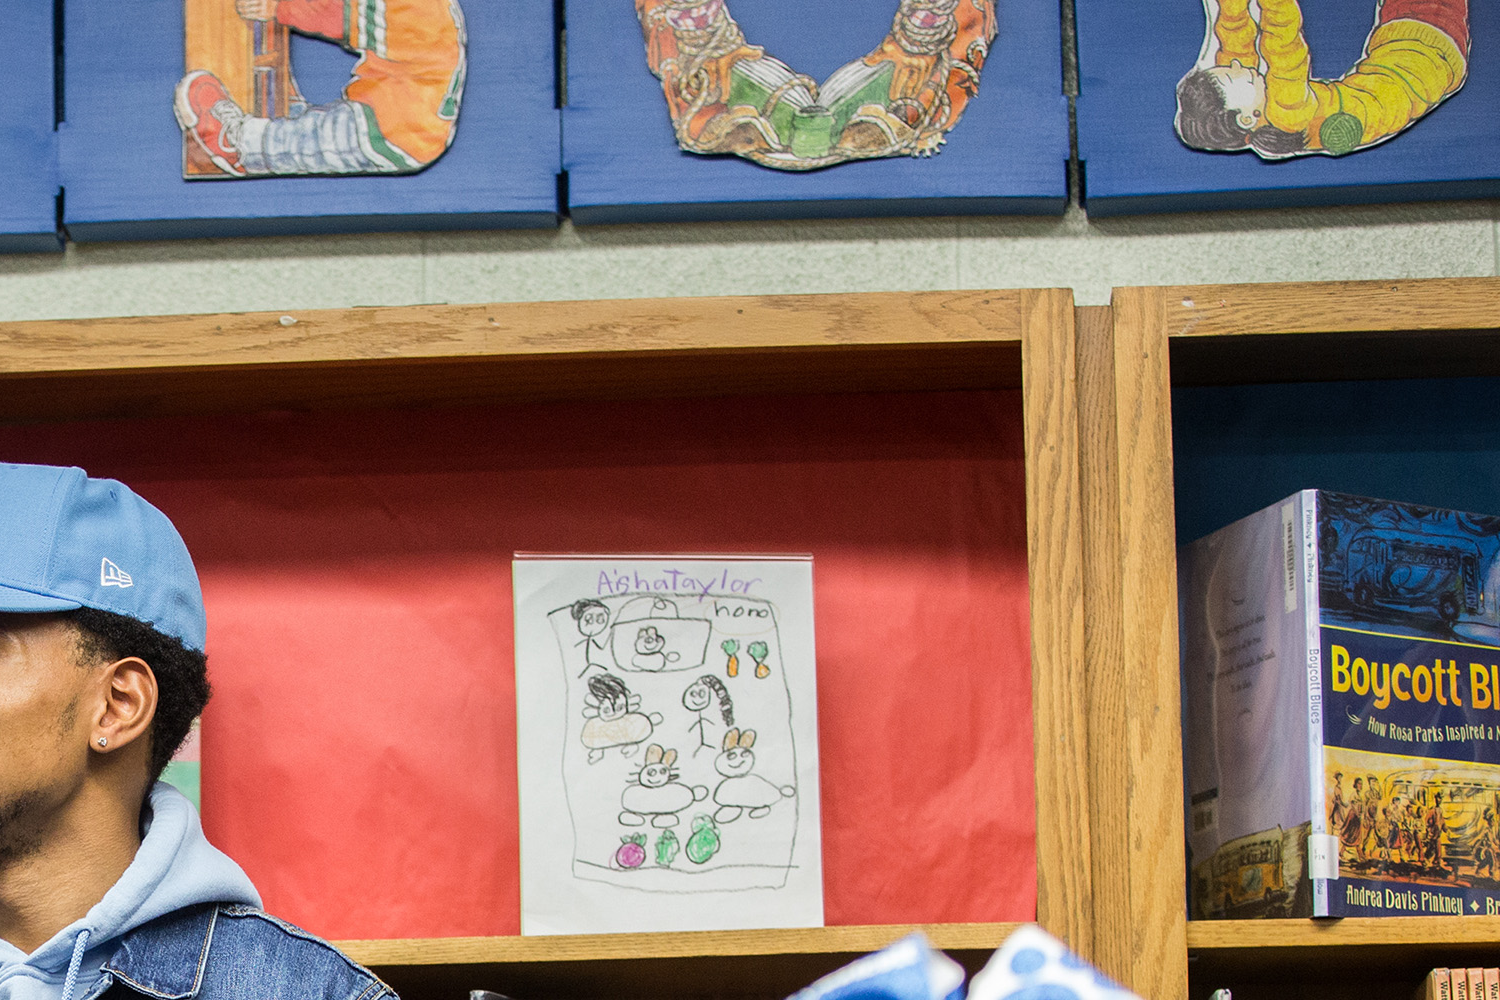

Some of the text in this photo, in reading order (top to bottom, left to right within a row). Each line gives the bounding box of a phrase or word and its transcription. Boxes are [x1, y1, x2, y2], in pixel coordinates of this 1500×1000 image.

[1308, 649, 1319, 690] Boycott
[1331, 644, 1462, 710] Boycott
[1310, 695, 1321, 724] Blues
[1367, 715, 1493, 743] How Rosa Parks Inspired a
[1346, 884, 1383, 908] Andrea
[1385, 888, 1418, 911] Davis
[1420, 891, 1464, 916] Pinkney
